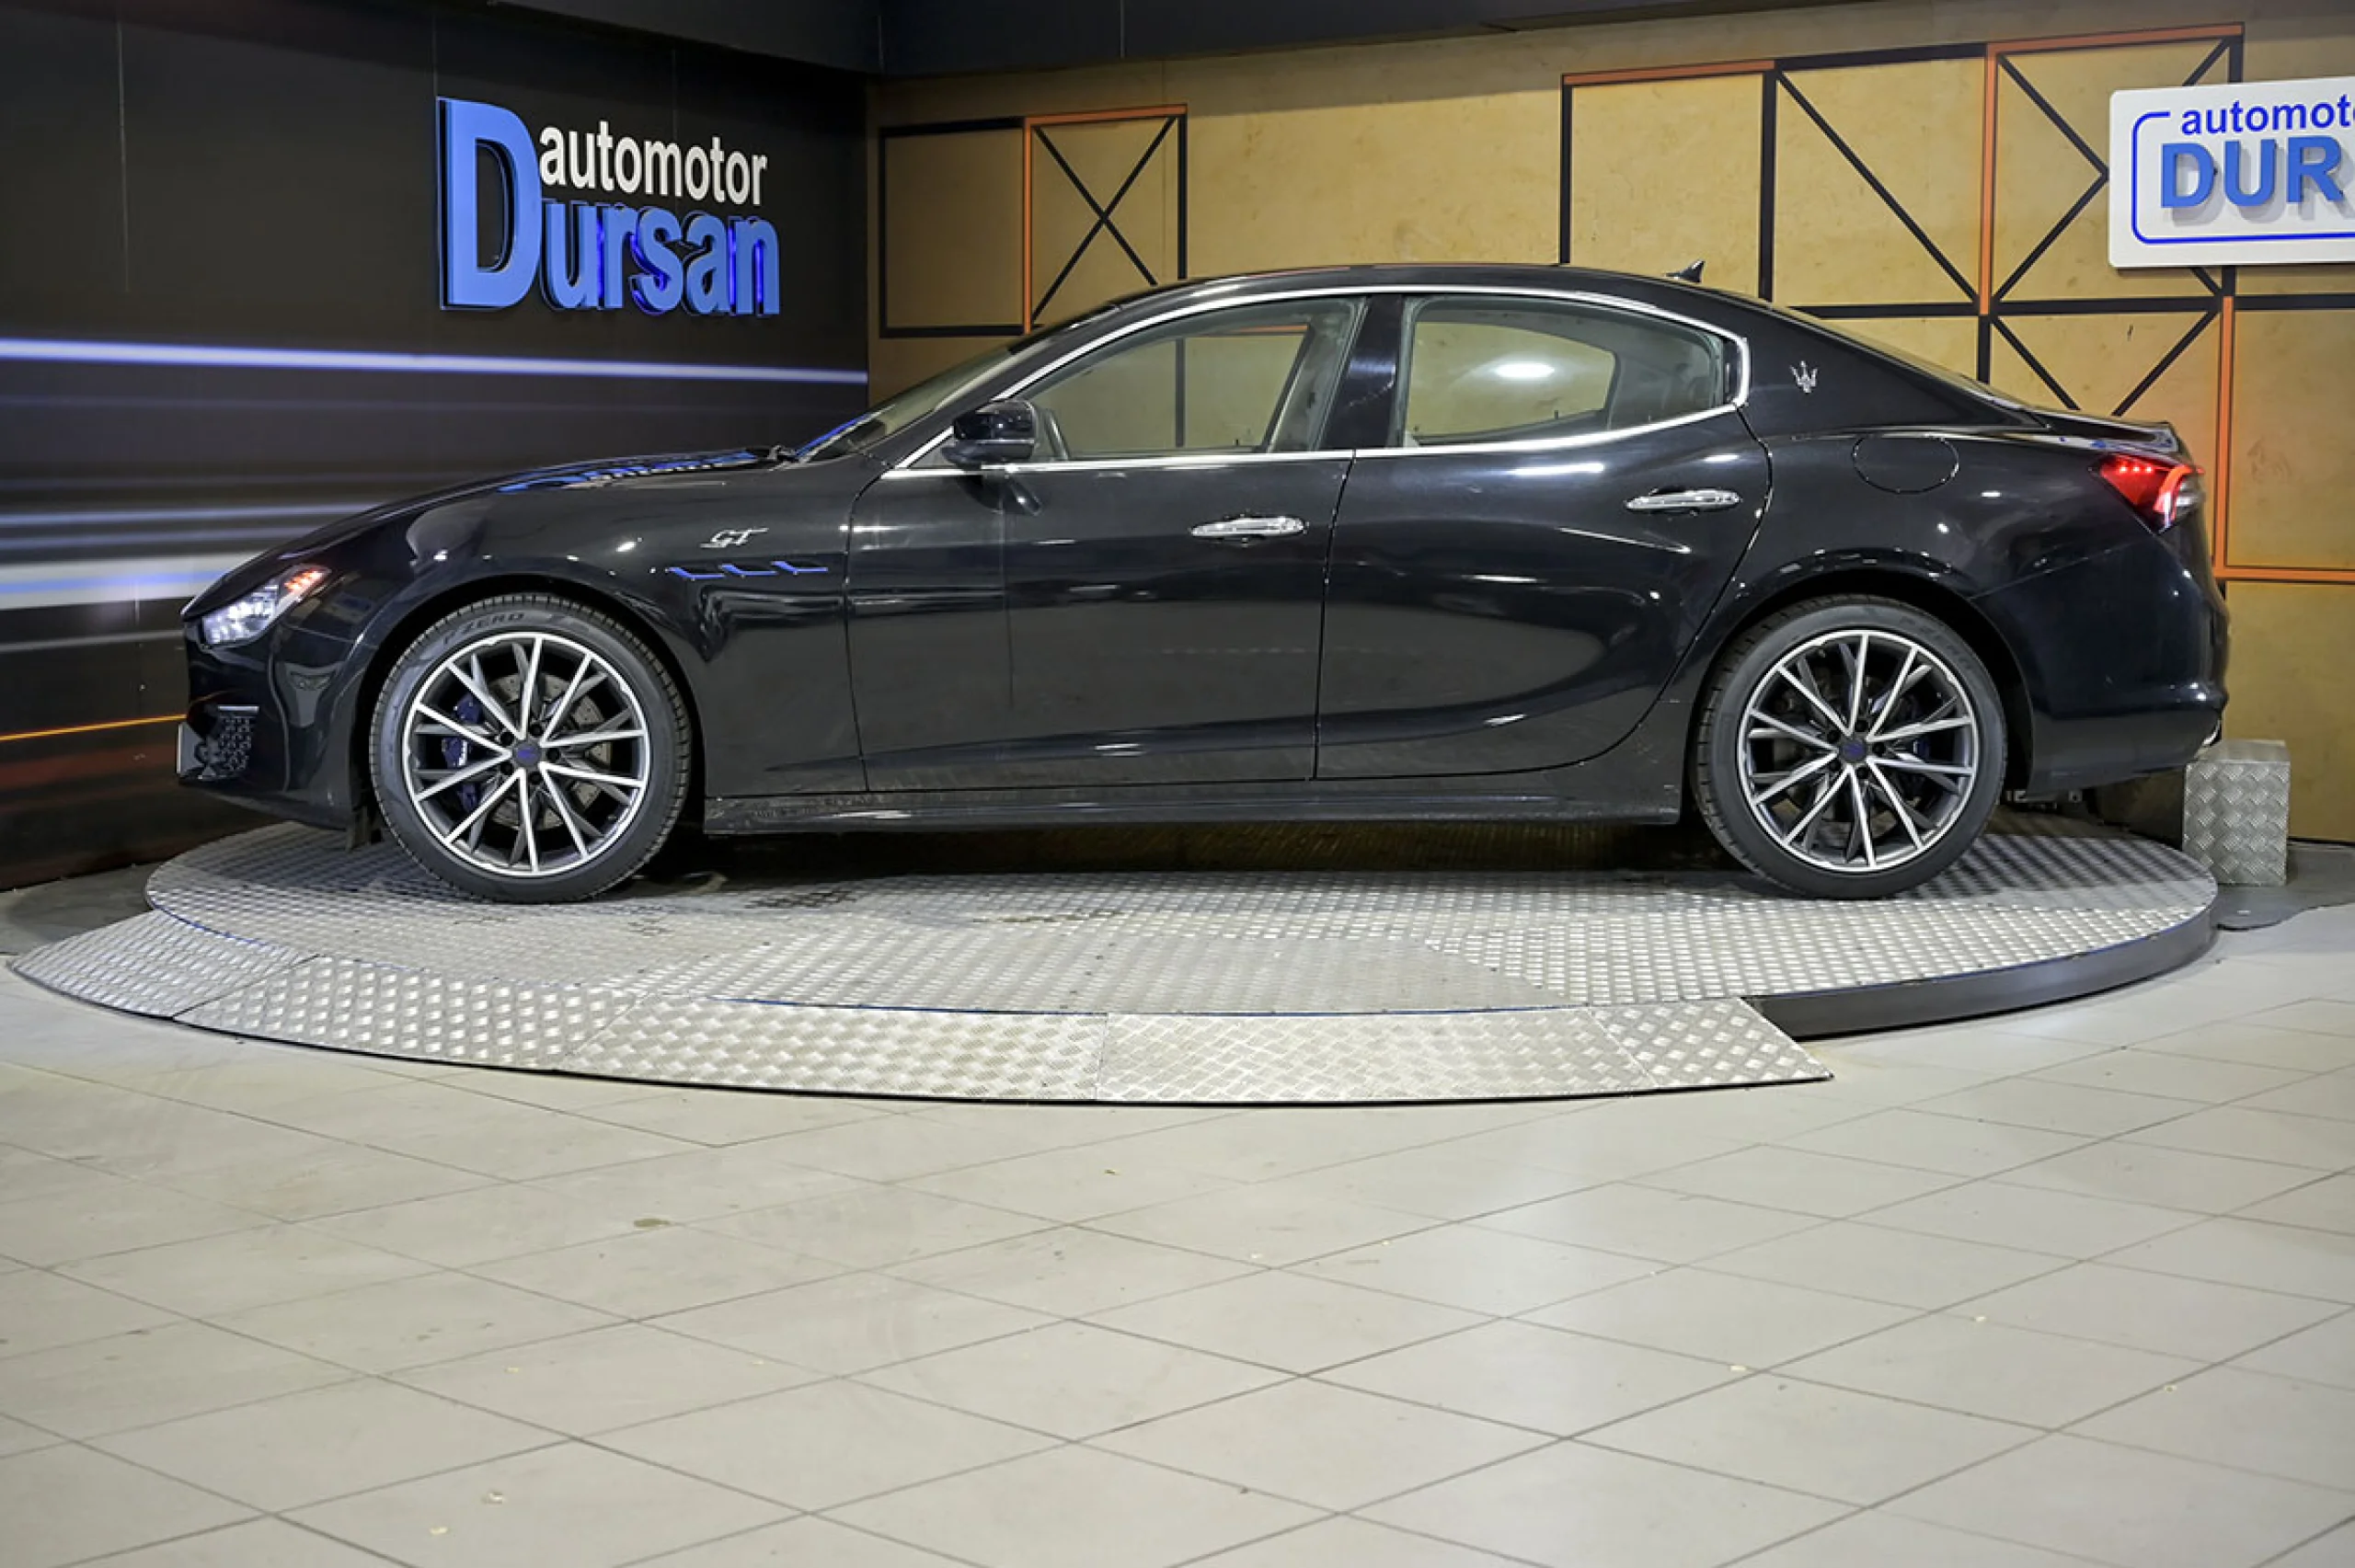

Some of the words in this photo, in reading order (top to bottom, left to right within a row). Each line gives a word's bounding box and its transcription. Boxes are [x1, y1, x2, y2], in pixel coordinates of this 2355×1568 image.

[2181, 94, 2355, 135] automot
[540, 120, 768, 206] automotor
[2161, 135, 2344, 209] DUR
[436, 96, 780, 317] Dursan
